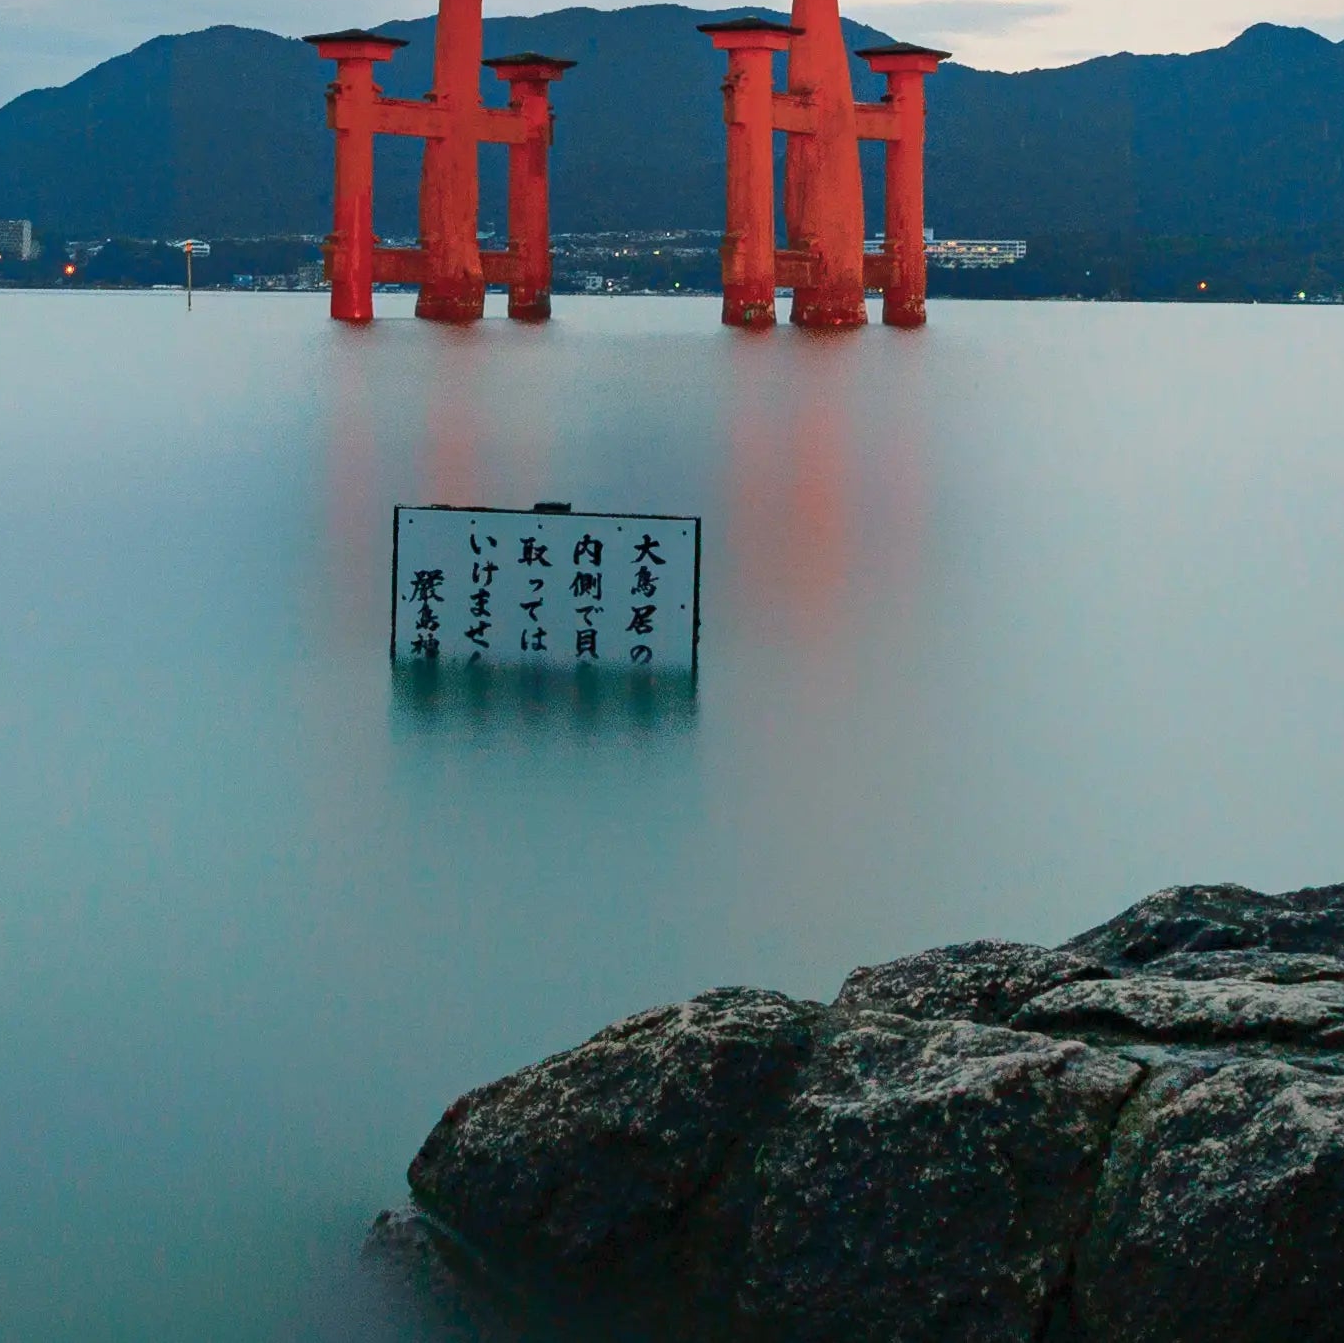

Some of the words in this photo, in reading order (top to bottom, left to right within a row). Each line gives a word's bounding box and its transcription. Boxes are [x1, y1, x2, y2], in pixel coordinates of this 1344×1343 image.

[518, 537, 553, 652] 取っては
[569, 534, 604, 658] 内側で貝
[626, 534, 666, 664] 大鳥居の
